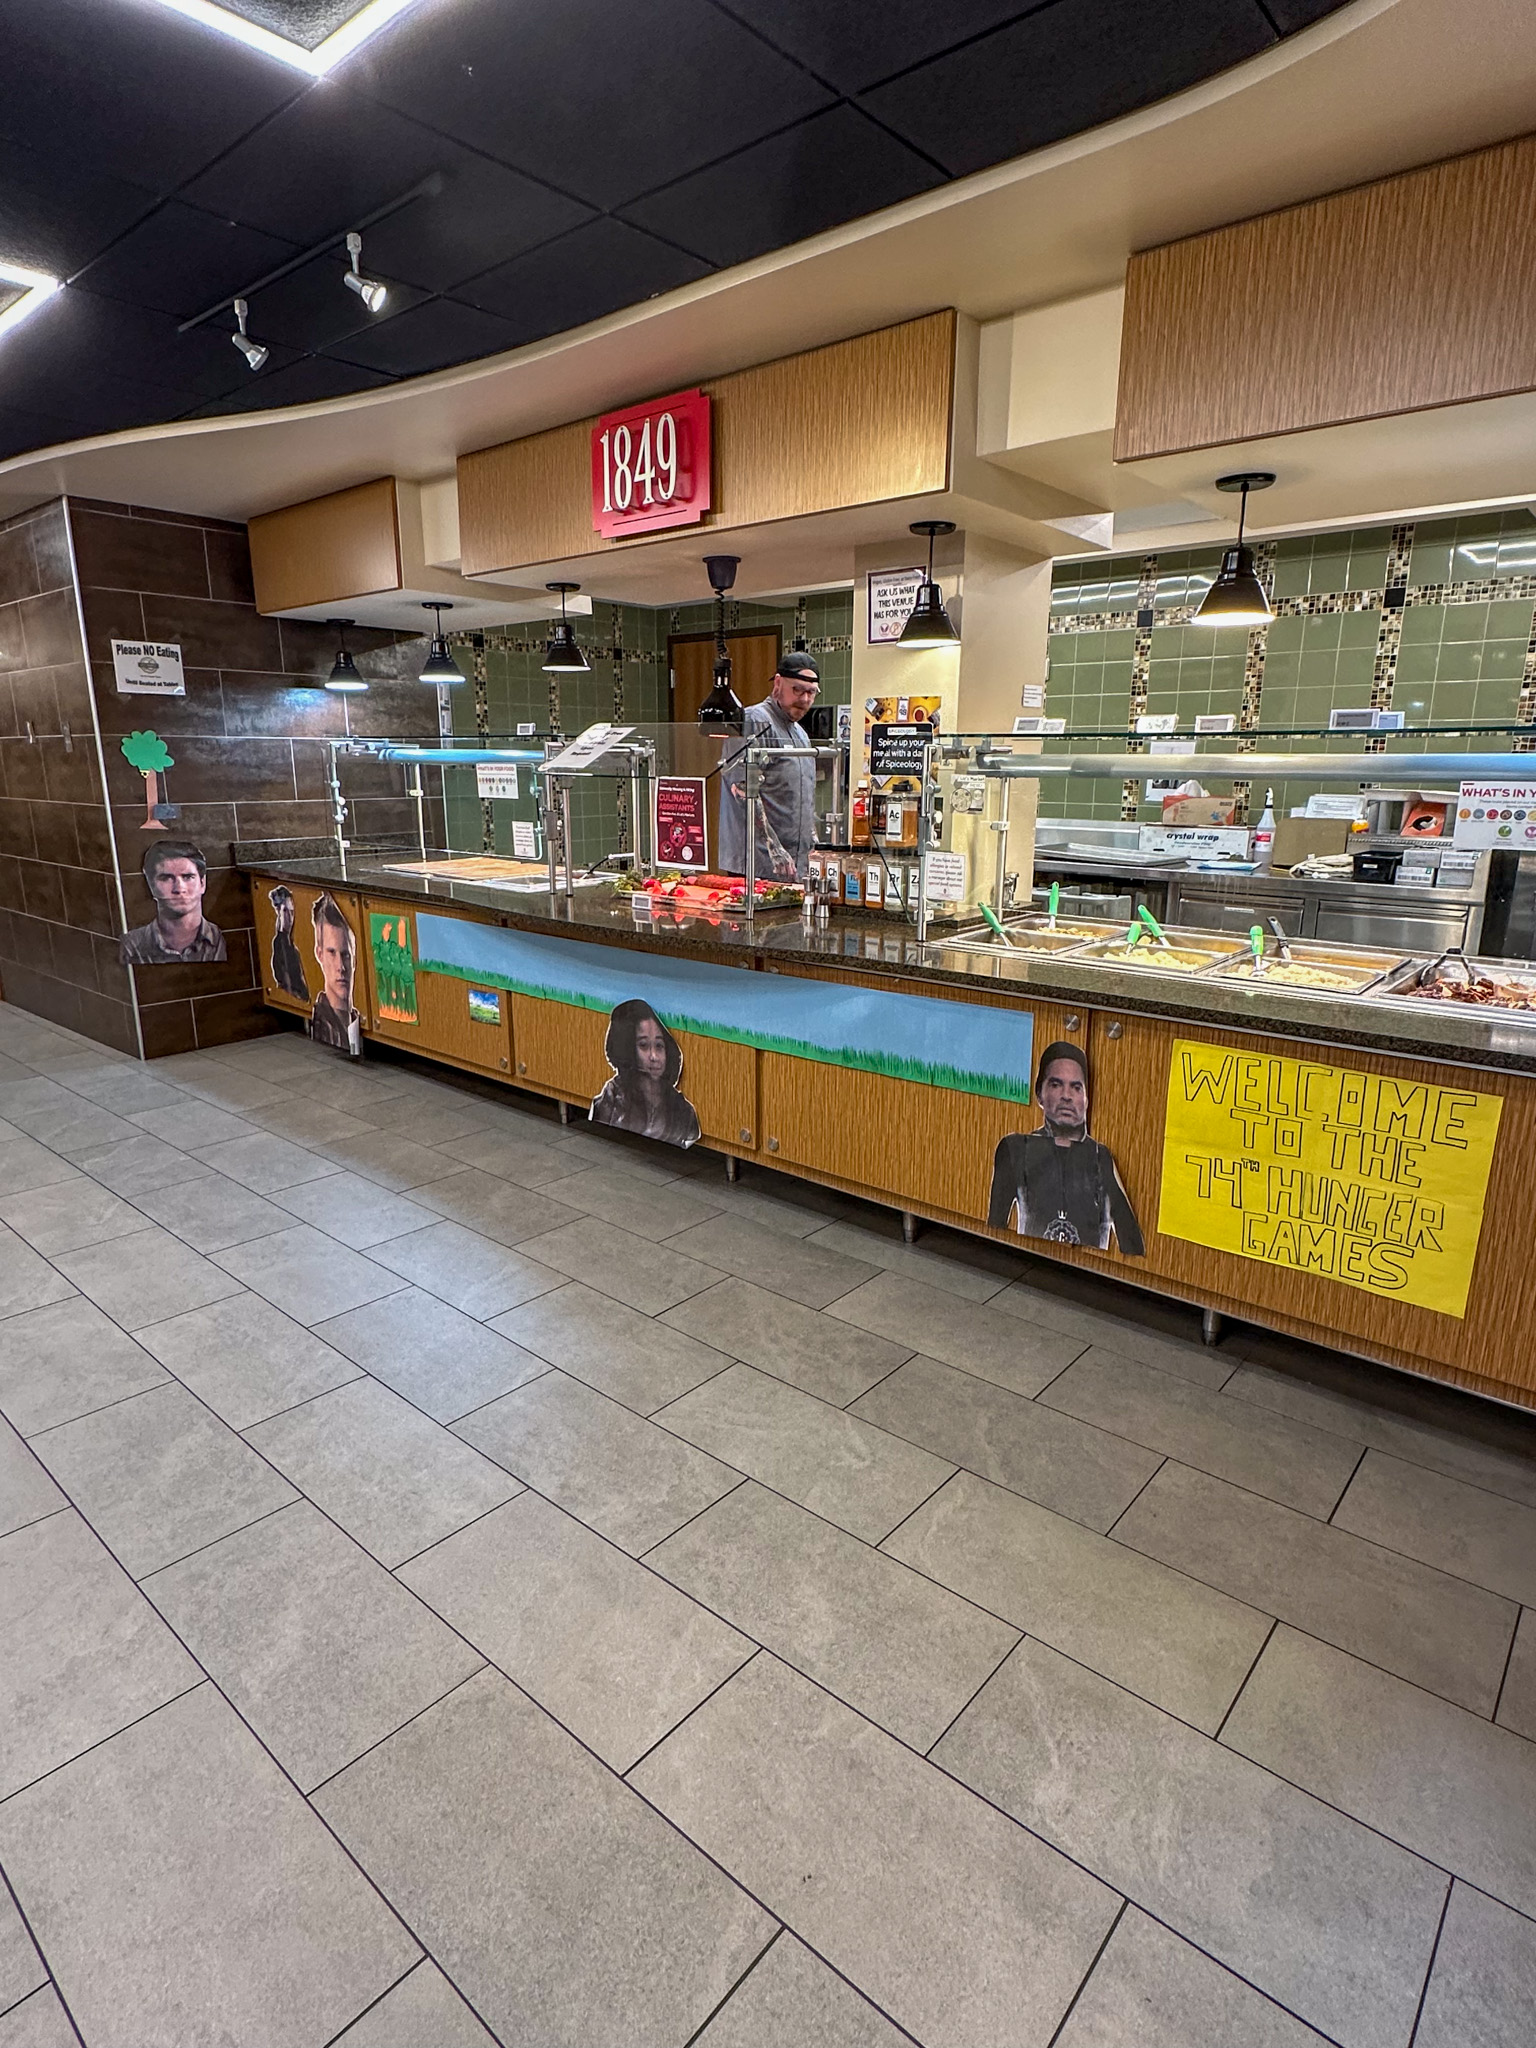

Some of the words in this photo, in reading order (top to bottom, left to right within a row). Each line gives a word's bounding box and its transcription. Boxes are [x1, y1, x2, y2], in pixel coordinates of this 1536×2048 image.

[600, 412, 677, 513] 1849
[877, 588, 888, 598] ASK
[889, 587, 898, 596] US
[900, 585, 916, 595] WHAT
[879, 599, 891, 608] THIS
[891, 597, 914, 607] VENUE
[874, 610, 884, 619] HAS
[886, 609, 899, 618] FOR
[116, 644, 141, 656] Please
[143, 644, 155, 656] NO
[156, 646, 179, 662] Eating
[878, 738, 897, 748] Spice
[899, 739, 908, 748] up
[909, 739, 925, 748] your
[873, 749, 890, 757] meal
[891, 749, 906, 757] with
[912, 749, 923, 757] da
[659, 793, 694, 803] CULINARY
[1462, 788, 1510, 798] WHAT'S
[1512, 788, 1527, 798] IN
[659, 803, 695, 812] ASSISTANTS
[889, 809, 900, 819] Ac
[1166, 832, 1195, 841] crystal
[1197, 834, 1220, 842] wrap
[810, 867, 820, 877] Bb
[828, 867, 837, 876] Ch
[869, 872, 879, 881] Th
[911, 875, 920, 884] Z
[1181, 1052, 1478, 1149] WELCOME
[1230, 1108, 1303, 1159] TO
[1322, 1123, 1427, 1189] THE
[1267, 1165, 1446, 1253] HUNGER
[1242, 1211, 1415, 1290] GAMES
